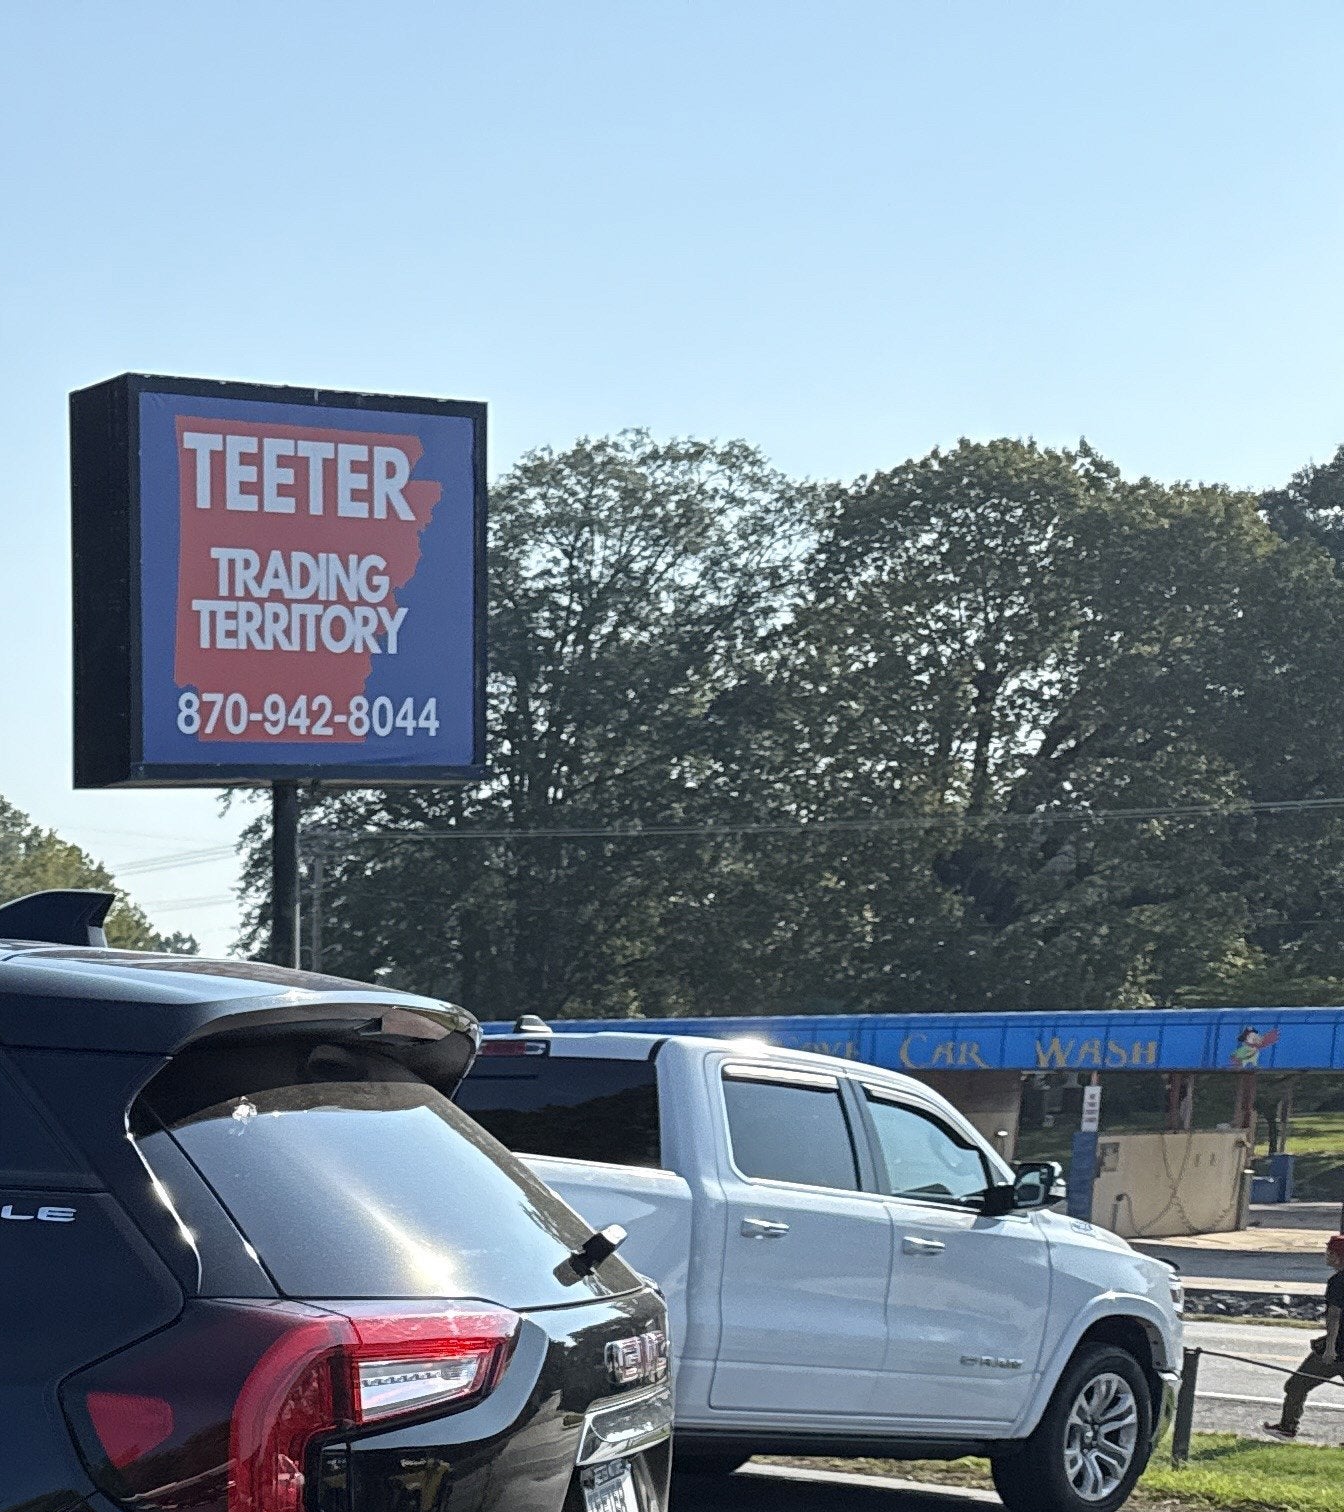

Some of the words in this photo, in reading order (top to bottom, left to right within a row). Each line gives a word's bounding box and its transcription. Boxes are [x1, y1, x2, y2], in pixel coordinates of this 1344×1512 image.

[183, 431, 415, 521] TEETER
[210, 546, 390, 603] TRADING
[191, 599, 409, 655] TERRITORY
[176, 691, 440, 738] 870-942-8044
